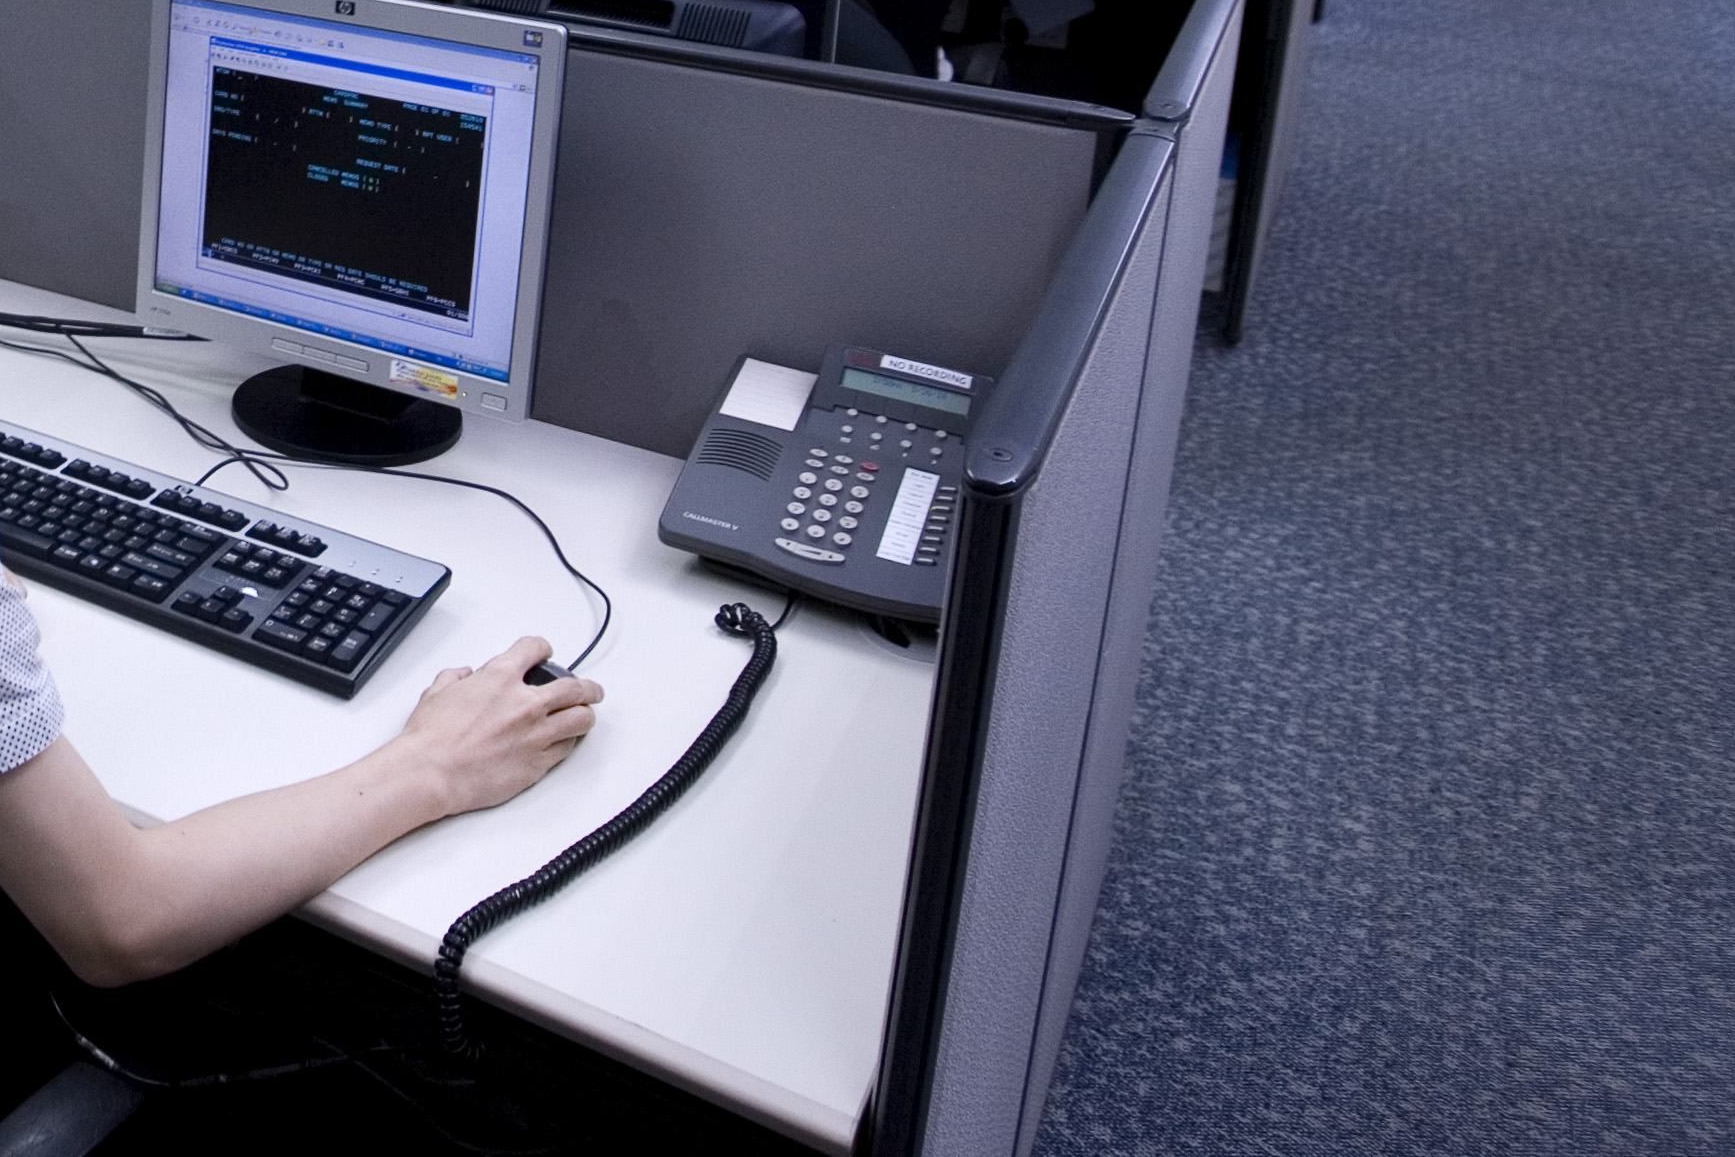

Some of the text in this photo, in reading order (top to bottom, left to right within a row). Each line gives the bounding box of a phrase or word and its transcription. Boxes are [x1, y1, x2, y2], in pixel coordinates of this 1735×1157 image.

[889, 360, 967, 384] NO RECORDING
[683, 512, 731, 529] CALLMASTER
